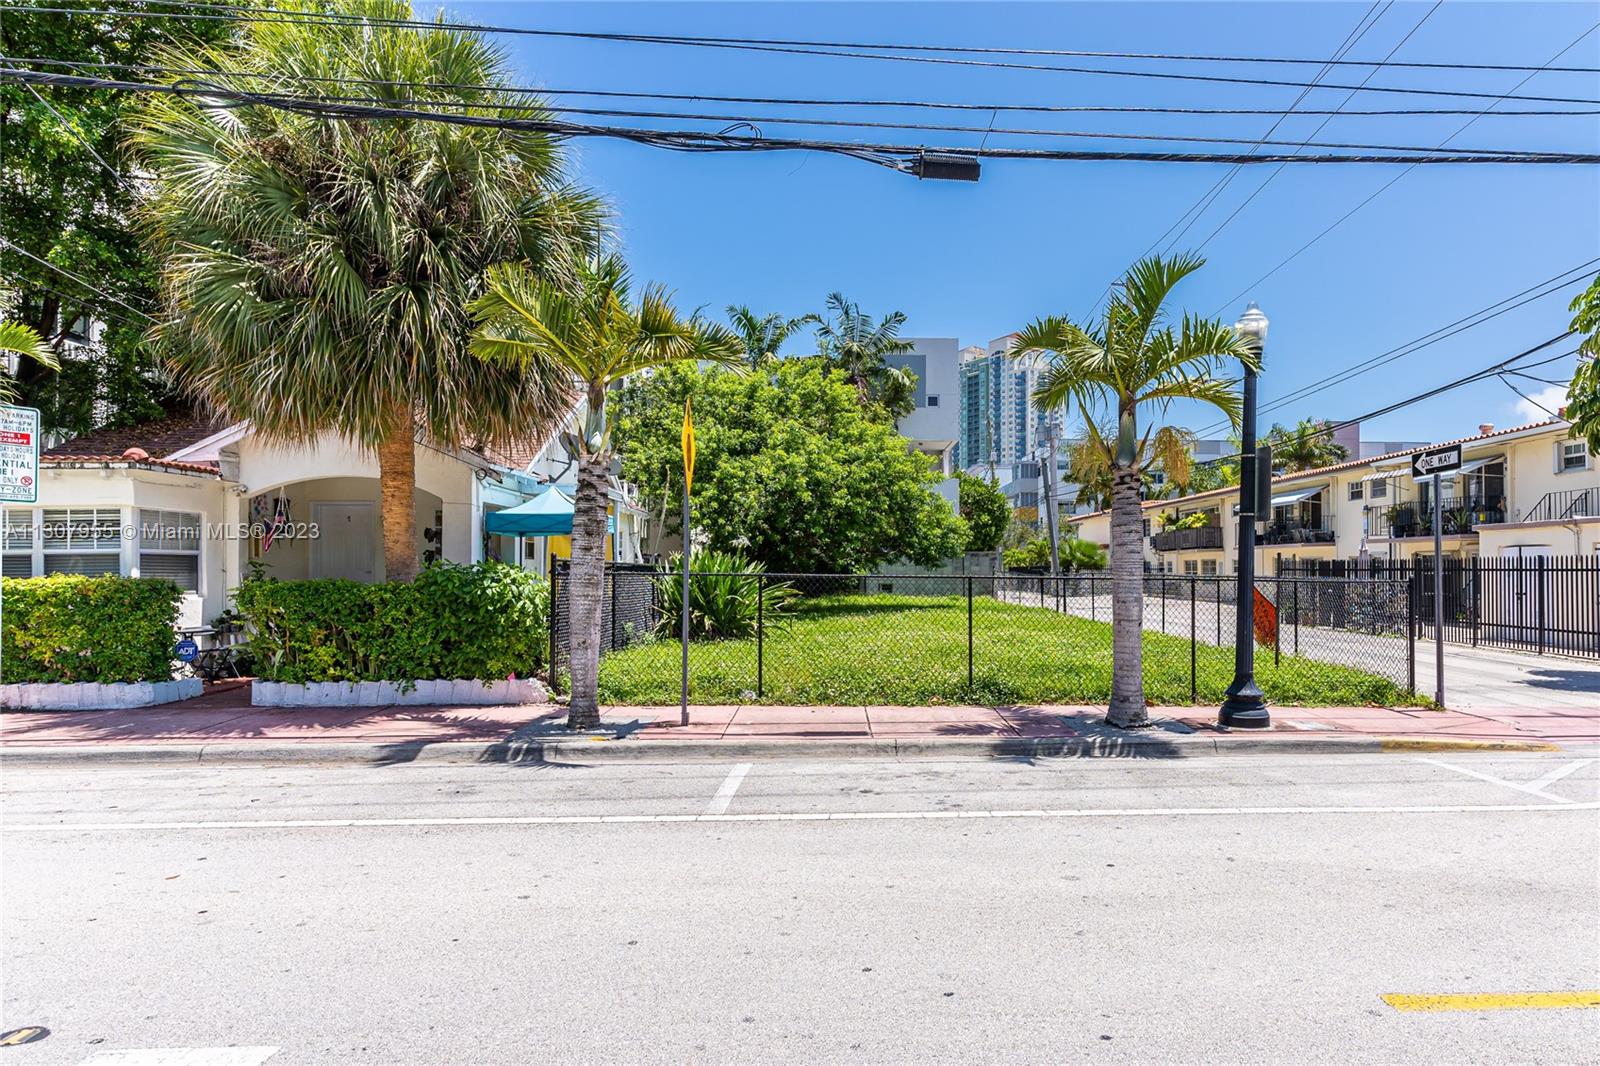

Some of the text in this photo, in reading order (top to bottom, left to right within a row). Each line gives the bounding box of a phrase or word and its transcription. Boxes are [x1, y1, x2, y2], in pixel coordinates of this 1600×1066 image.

[3, 425, 33, 434] HOLIDAYS
[1421, 454, 1452, 469] ONE WAY
[178, 646, 195, 655] ADT
